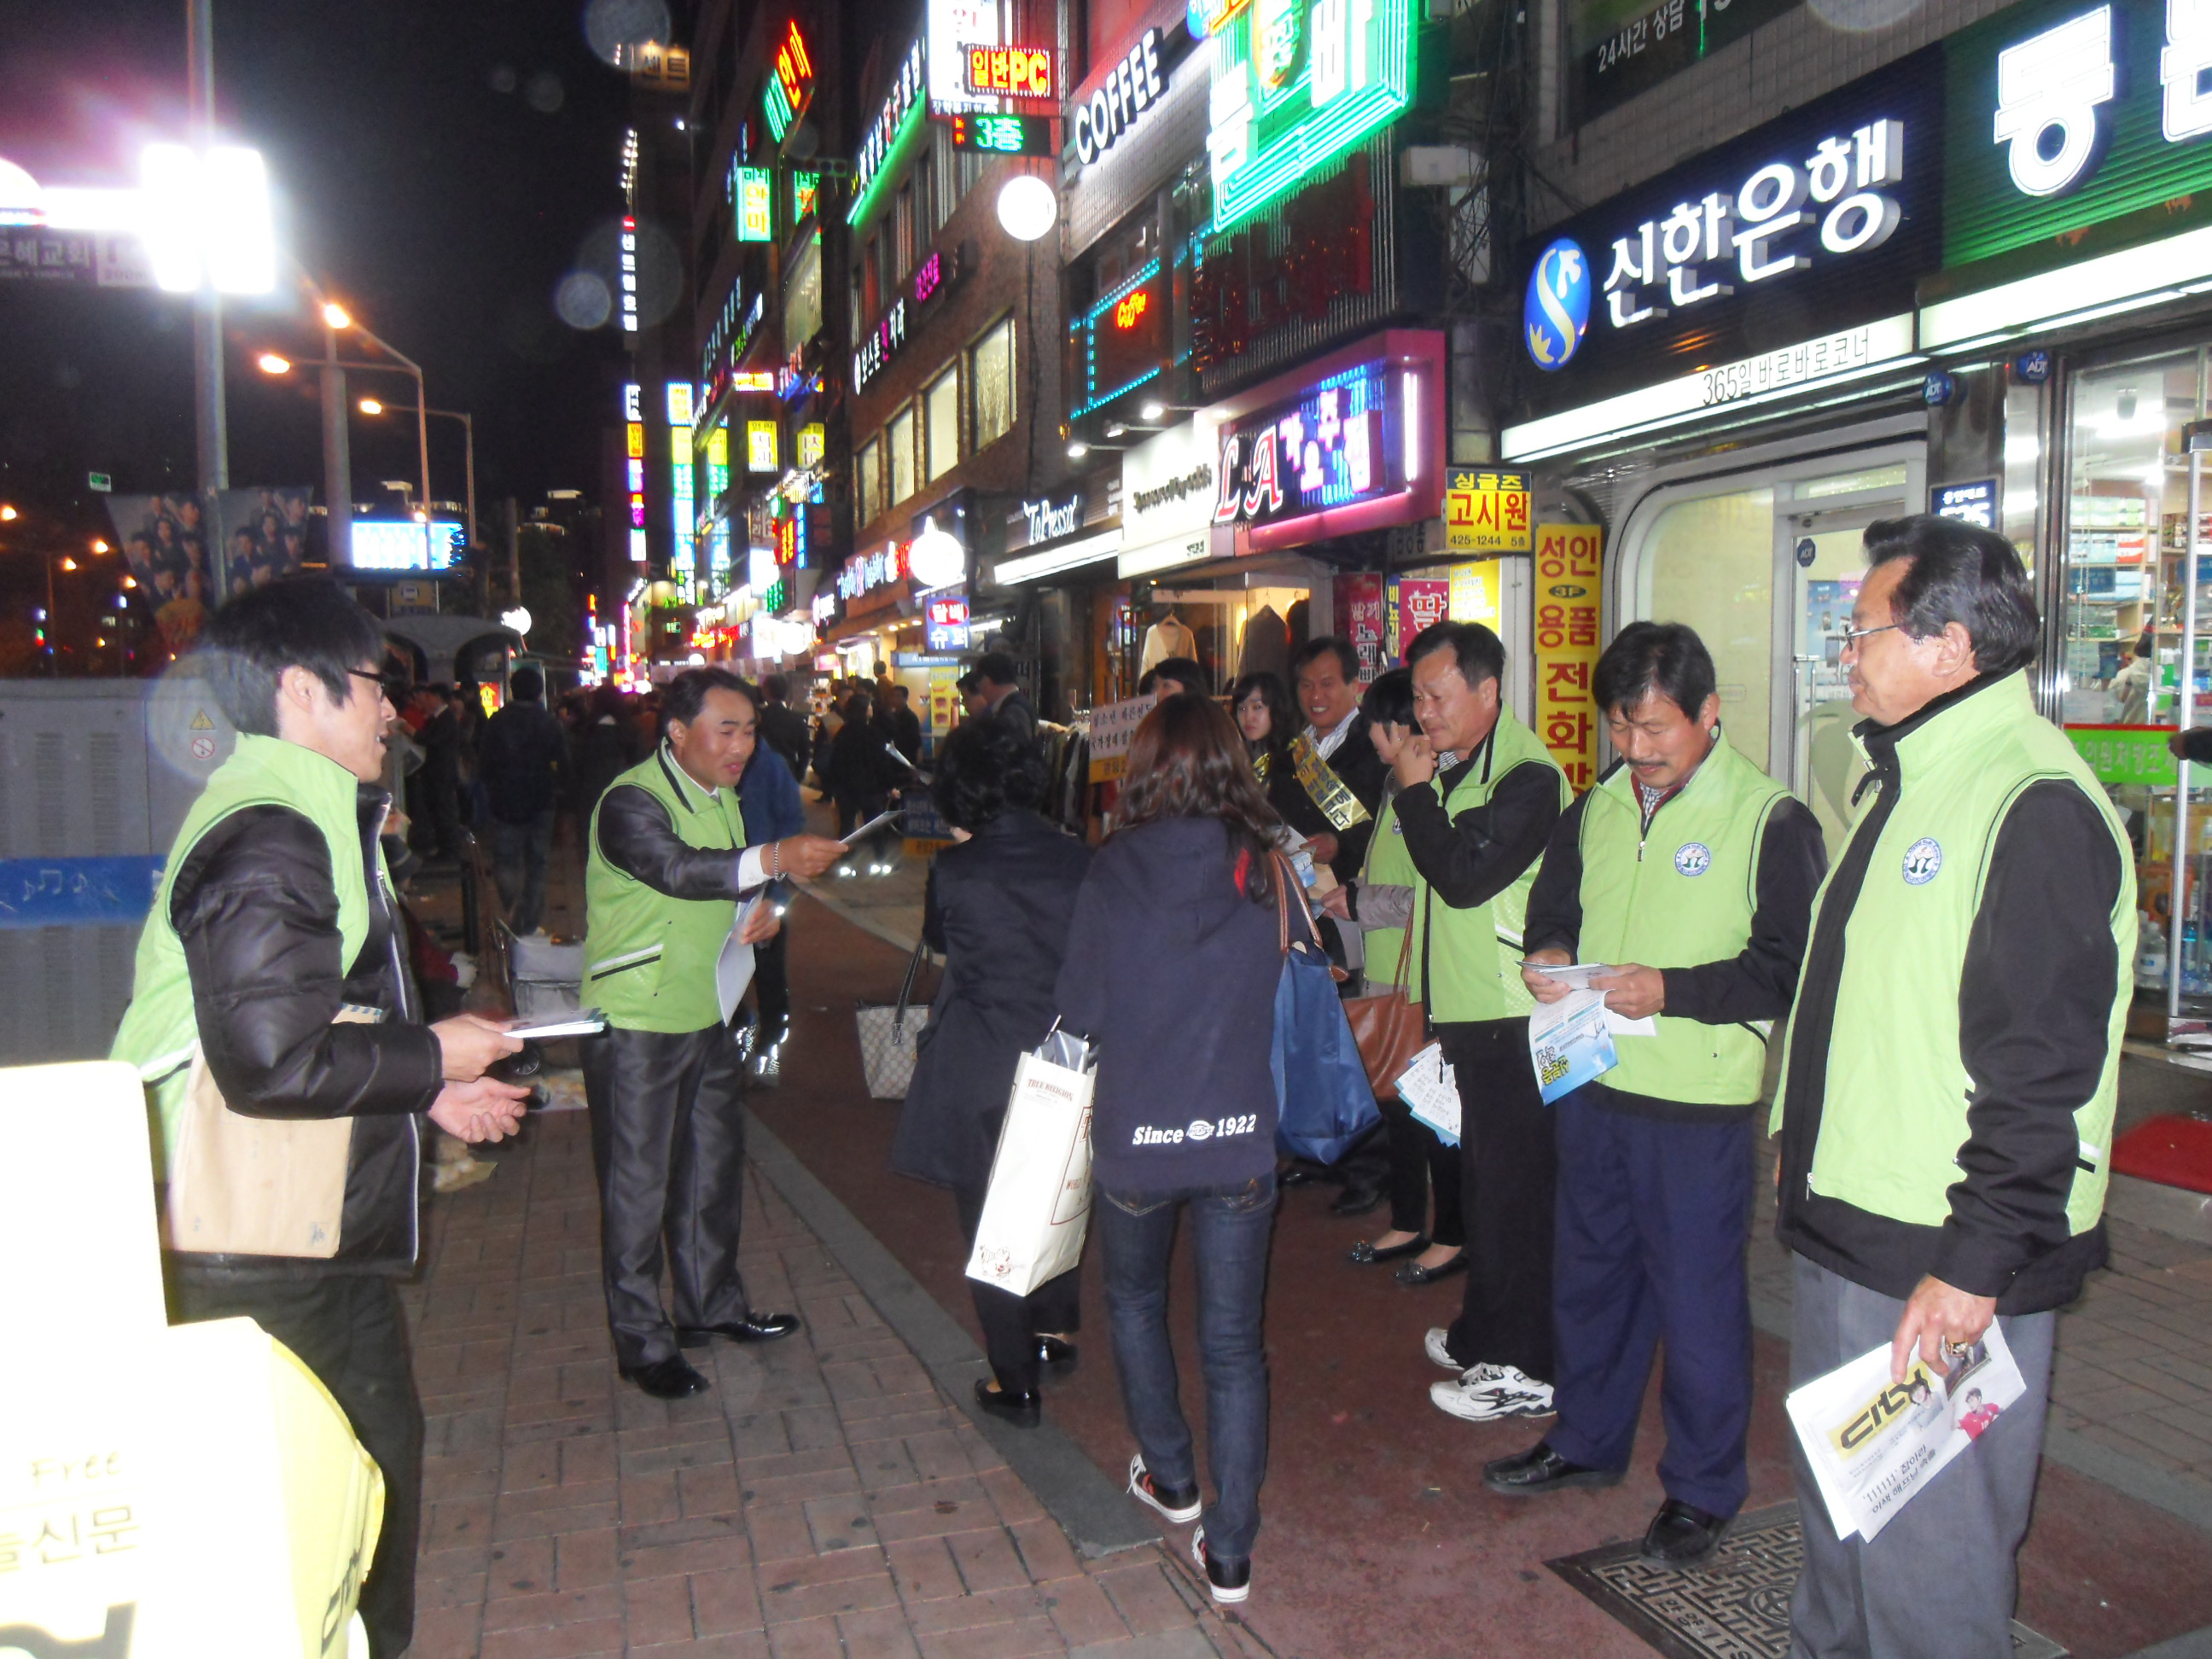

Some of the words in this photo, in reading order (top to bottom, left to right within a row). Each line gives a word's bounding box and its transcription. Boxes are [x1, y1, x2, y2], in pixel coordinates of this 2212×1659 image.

[1598, 19, 1648, 73] 24시간
[1652, 0, 1685, 41] 상담
[972, 50, 1048, 96] 일반PC
[1075, 27, 1161, 164] COFFEE
[975, 117, 1024, 152] 3층
[1604, 119, 1900, 328] 신한은행
[1703, 360, 1750, 406] 365일
[1758, 327, 1869, 391] 바로바로코너
[2027, 360, 2047, 375] ADT
[1214, 426, 1284, 525] LA
[1279, 387, 1372, 494] 가요주점
[1453, 472, 1523, 491] 싱글즈
[1448, 492, 1528, 532] 고시원
[1450, 534, 1502, 546] 425-1244
[1539, 535, 1597, 579] 성인
[1555, 585, 1582, 597] 3F
[931, 603, 965, 624] 담배
[1351, 600, 1381, 622] 딸기
[1538, 604, 1597, 649] 용품
[930, 626, 969, 650] 슈퍼
[1132, 1126, 1185, 1145] Since
[1216, 1114, 1257, 1138] 1922
[30, 1450, 123, 1489] Free
